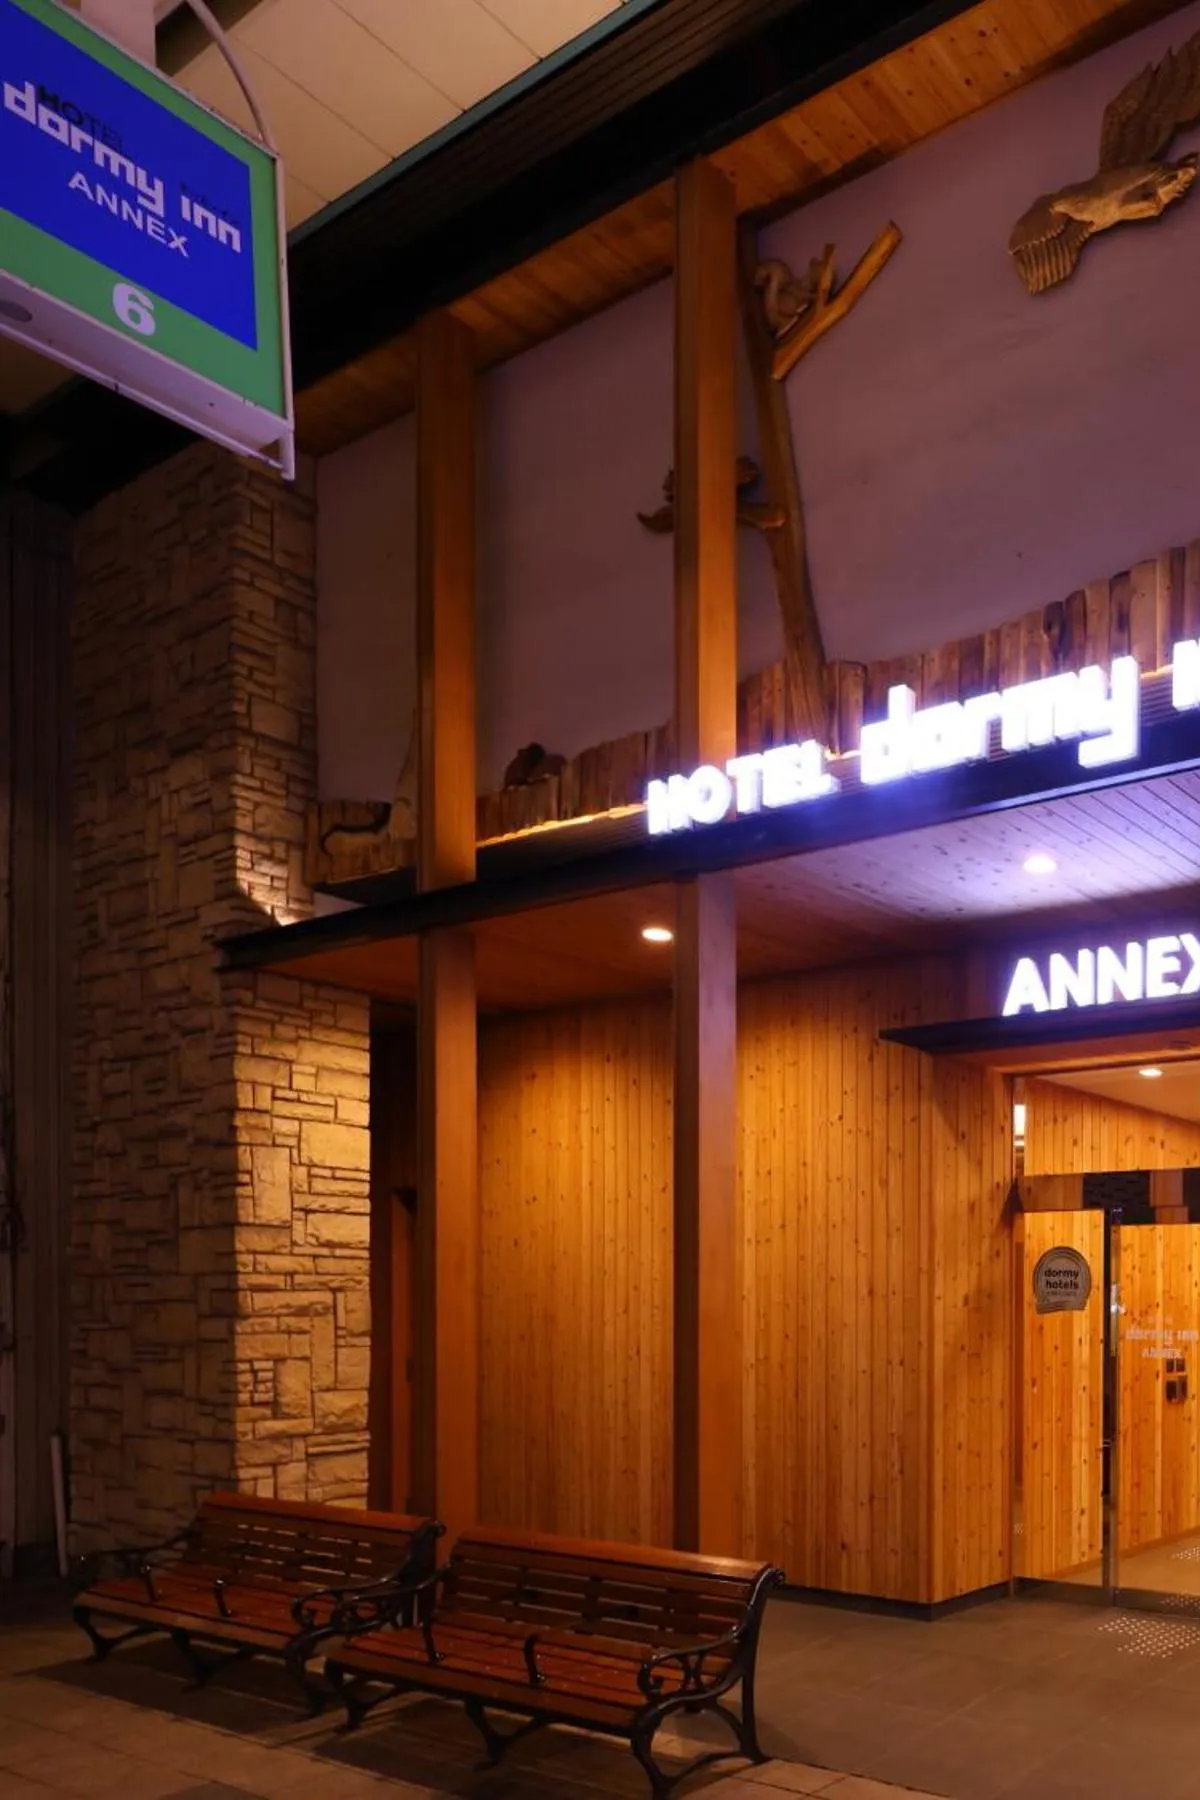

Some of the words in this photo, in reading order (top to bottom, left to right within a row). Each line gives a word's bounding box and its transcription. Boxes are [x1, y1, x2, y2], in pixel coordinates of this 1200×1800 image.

[3, 81, 165, 218] dormy
[180, 195, 241, 254] inn
[68, 171, 189, 259] ANNEX
[112, 282, 156, 336] 6
[647, 739, 839, 835] HOTEL
[860, 655, 1140, 785] dormy
[1044, 1268, 1079, 1281] dormy
[1045, 1279, 1079, 1290] hotels
